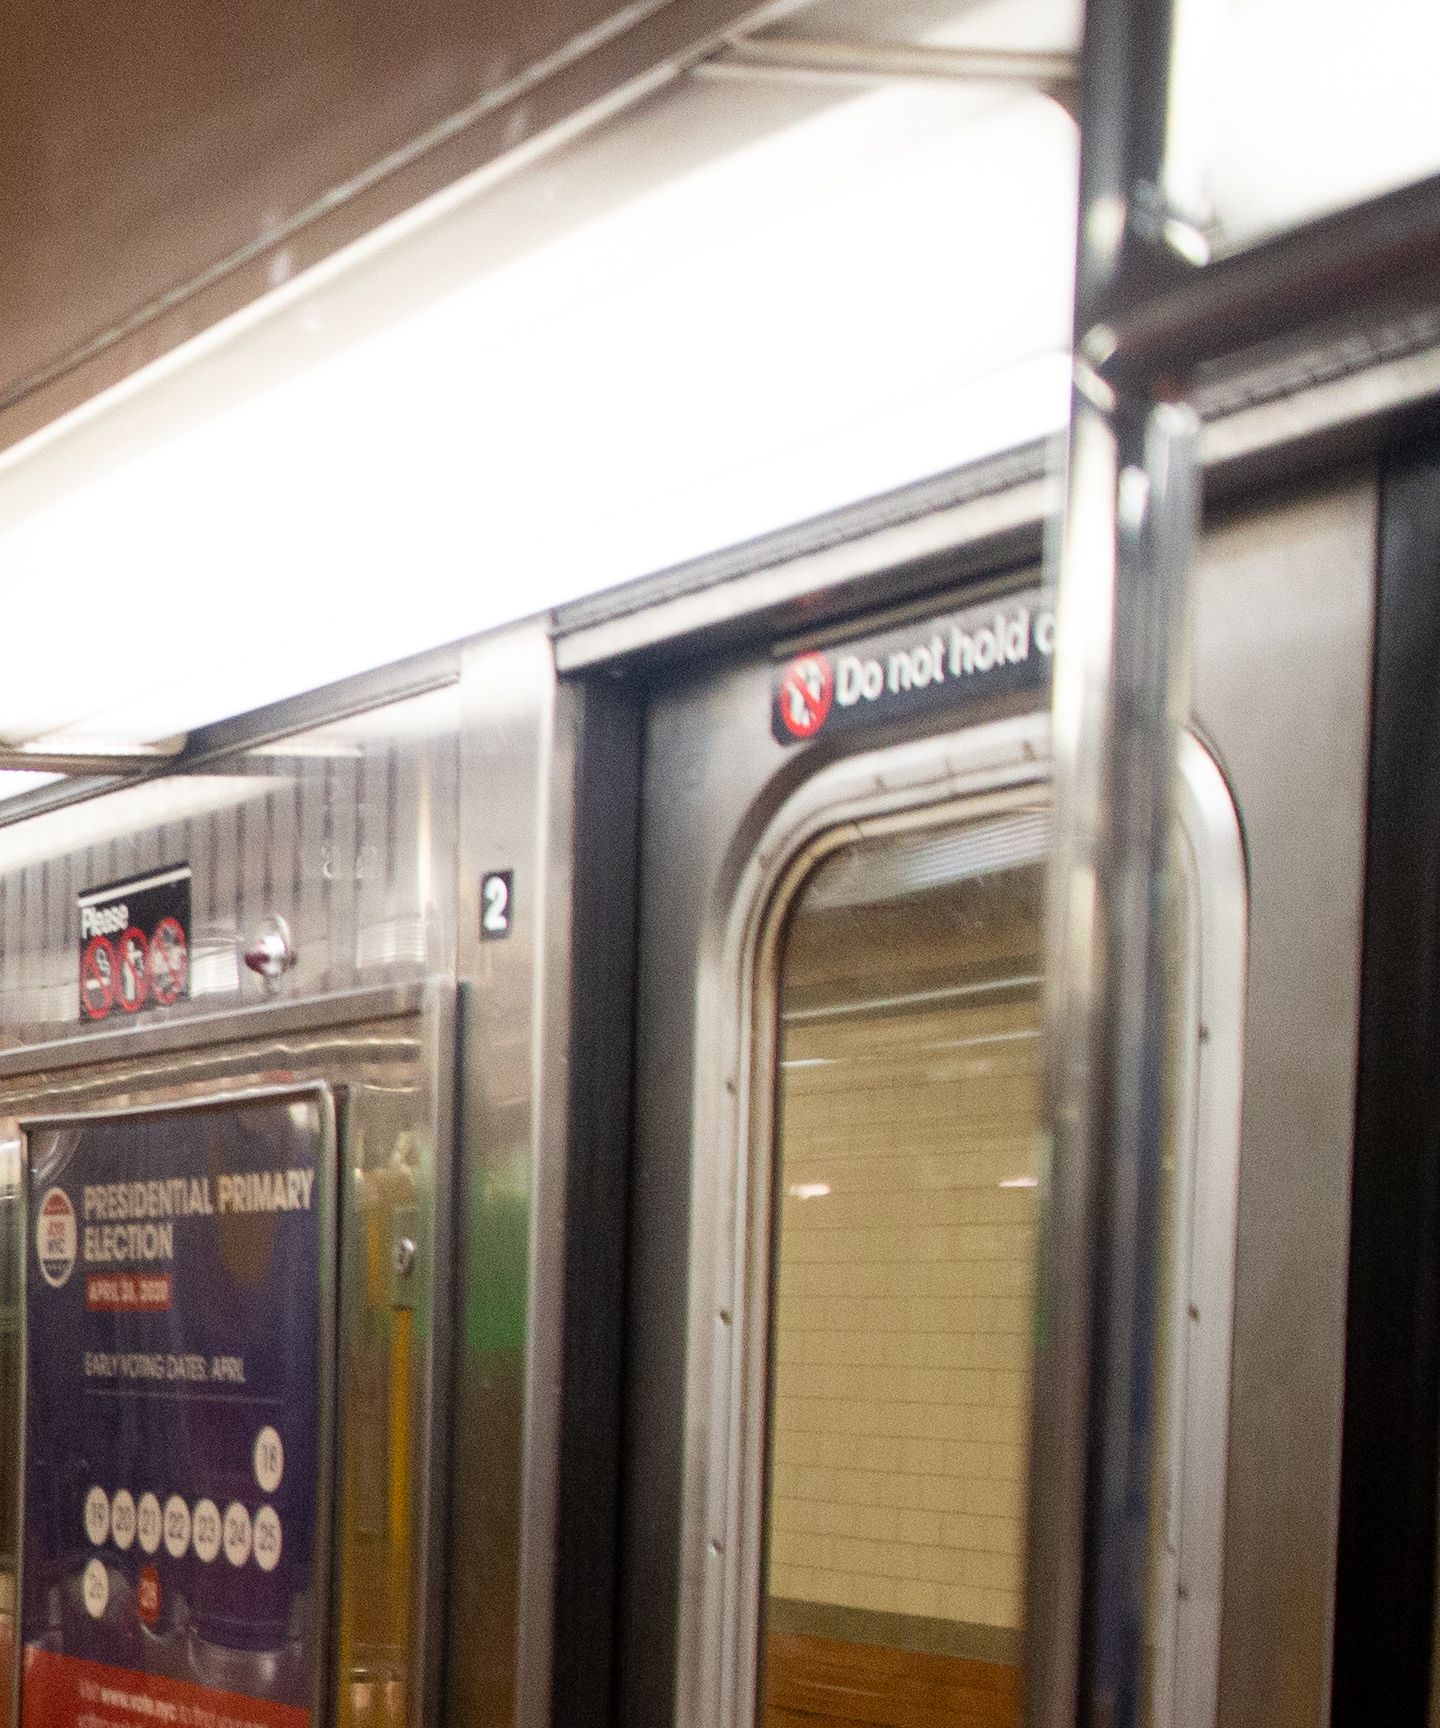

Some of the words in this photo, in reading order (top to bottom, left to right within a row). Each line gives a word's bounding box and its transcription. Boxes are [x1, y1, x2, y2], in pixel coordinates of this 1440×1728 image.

[835, 656, 883, 706] Do
[887, 635, 944, 694] not
[948, 608, 1030, 677] hold
[82, 904, 129, 939] Please
[482, 875, 529, 932] 2
[83, 1178, 213, 1221] PRESIDENTIAL
[216, 1169, 315, 1213] PRIMARY
[83, 1223, 175, 1262] ELECTION
[83, 1352, 118, 1377] EARLY
[118, 1353, 164, 1380] VOTING
[211, 1355, 247, 1384] APRIL
[262, 1444, 280, 1473] 18
[90, 1502, 106, 1527] 19
[115, 1504, 133, 1531] 20
[140, 1507, 157, 1536] 21
[168, 1510, 185, 1539] 22
[198, 1515, 217, 1543] 23
[228, 1518, 247, 1547] 24
[260, 1521, 277, 1551] 25
